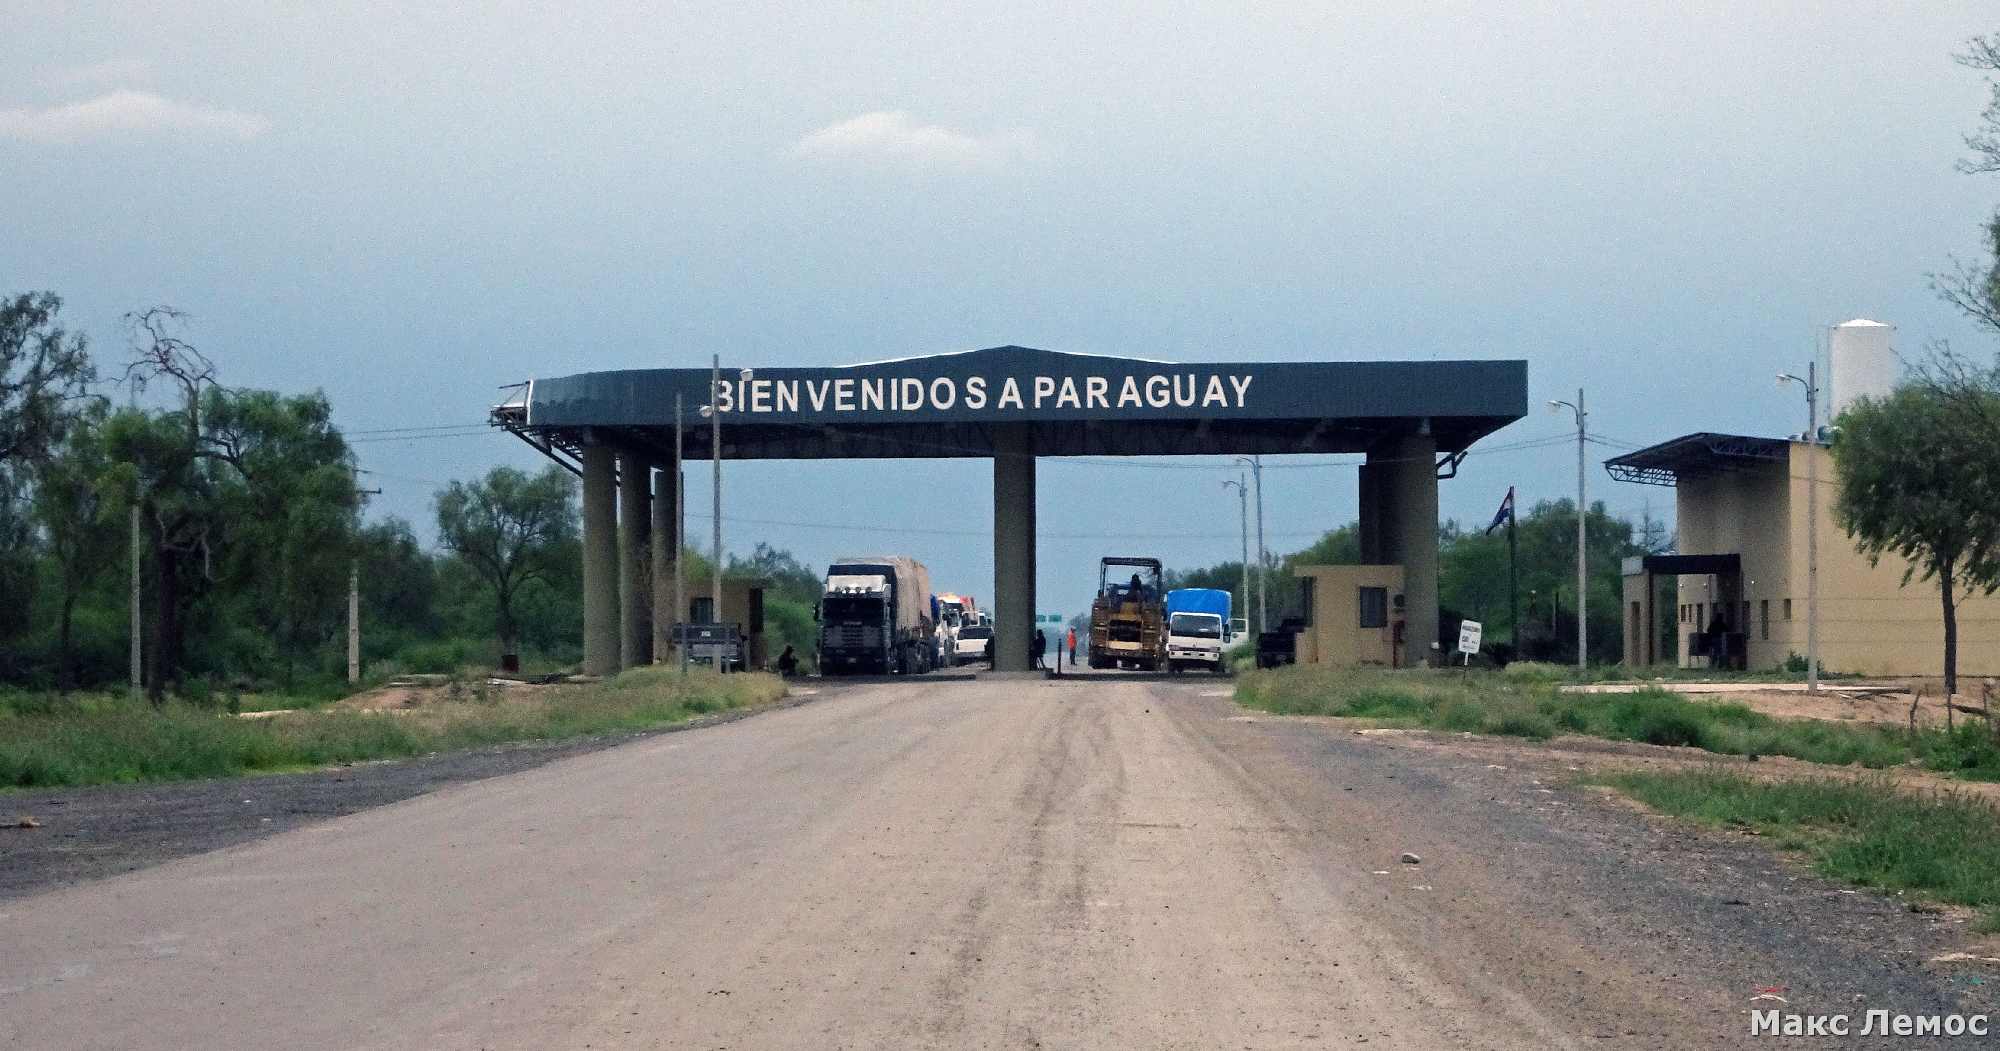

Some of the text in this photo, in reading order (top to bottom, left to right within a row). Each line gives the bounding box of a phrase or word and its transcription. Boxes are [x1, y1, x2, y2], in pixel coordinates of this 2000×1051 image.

[712, 374, 1253, 413] BIENVENIDOS A PARAGUAY
